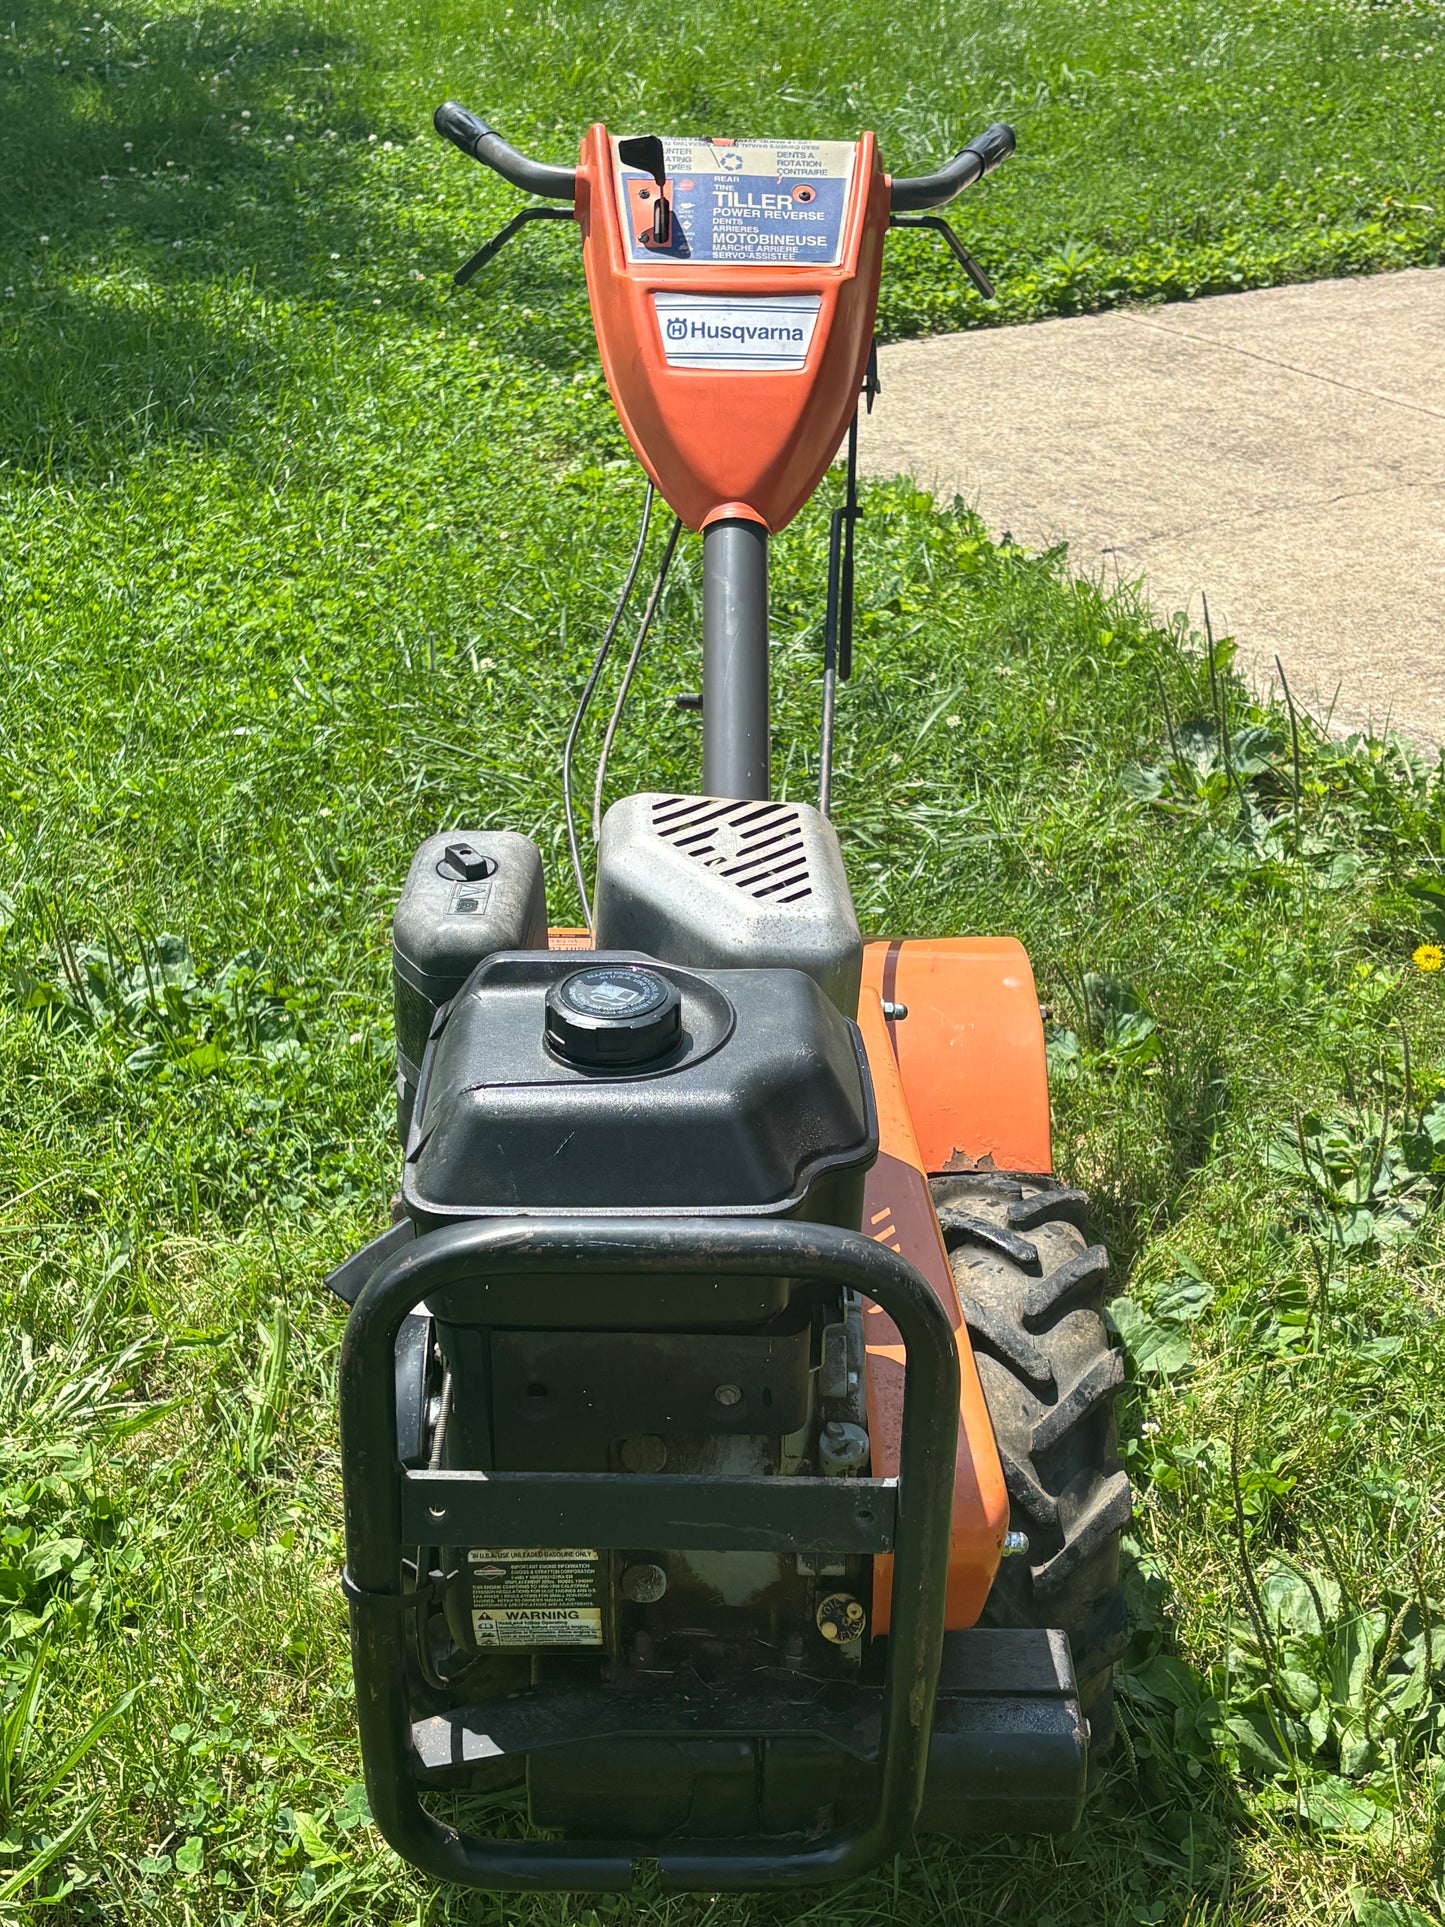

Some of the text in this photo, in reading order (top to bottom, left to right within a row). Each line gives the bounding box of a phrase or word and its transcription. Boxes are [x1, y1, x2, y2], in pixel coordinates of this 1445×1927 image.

[776, 151, 806, 159] DENTS
[776, 160, 822, 168] ROTATION
[776, 168, 829, 176] CONTRAIRE
[714, 175, 740, 183] REAR
[714, 184, 735, 192] TINE
[712, 191, 793, 211] TILLER
[712, 208, 825, 221] POWER REVERSE
[712, 218, 743, 226] DENTS
[712, 225, 759, 234] ARRIERES
[712, 232, 828, 247] MOTOBINEUSE
[712, 244, 800, 254] MARCHE ARRIERE
[712, 252, 796, 261] SERVO-ASSISTEE
[690, 321, 804, 344] Husqvarna
[506, 1610, 580, 1620] WARNING
